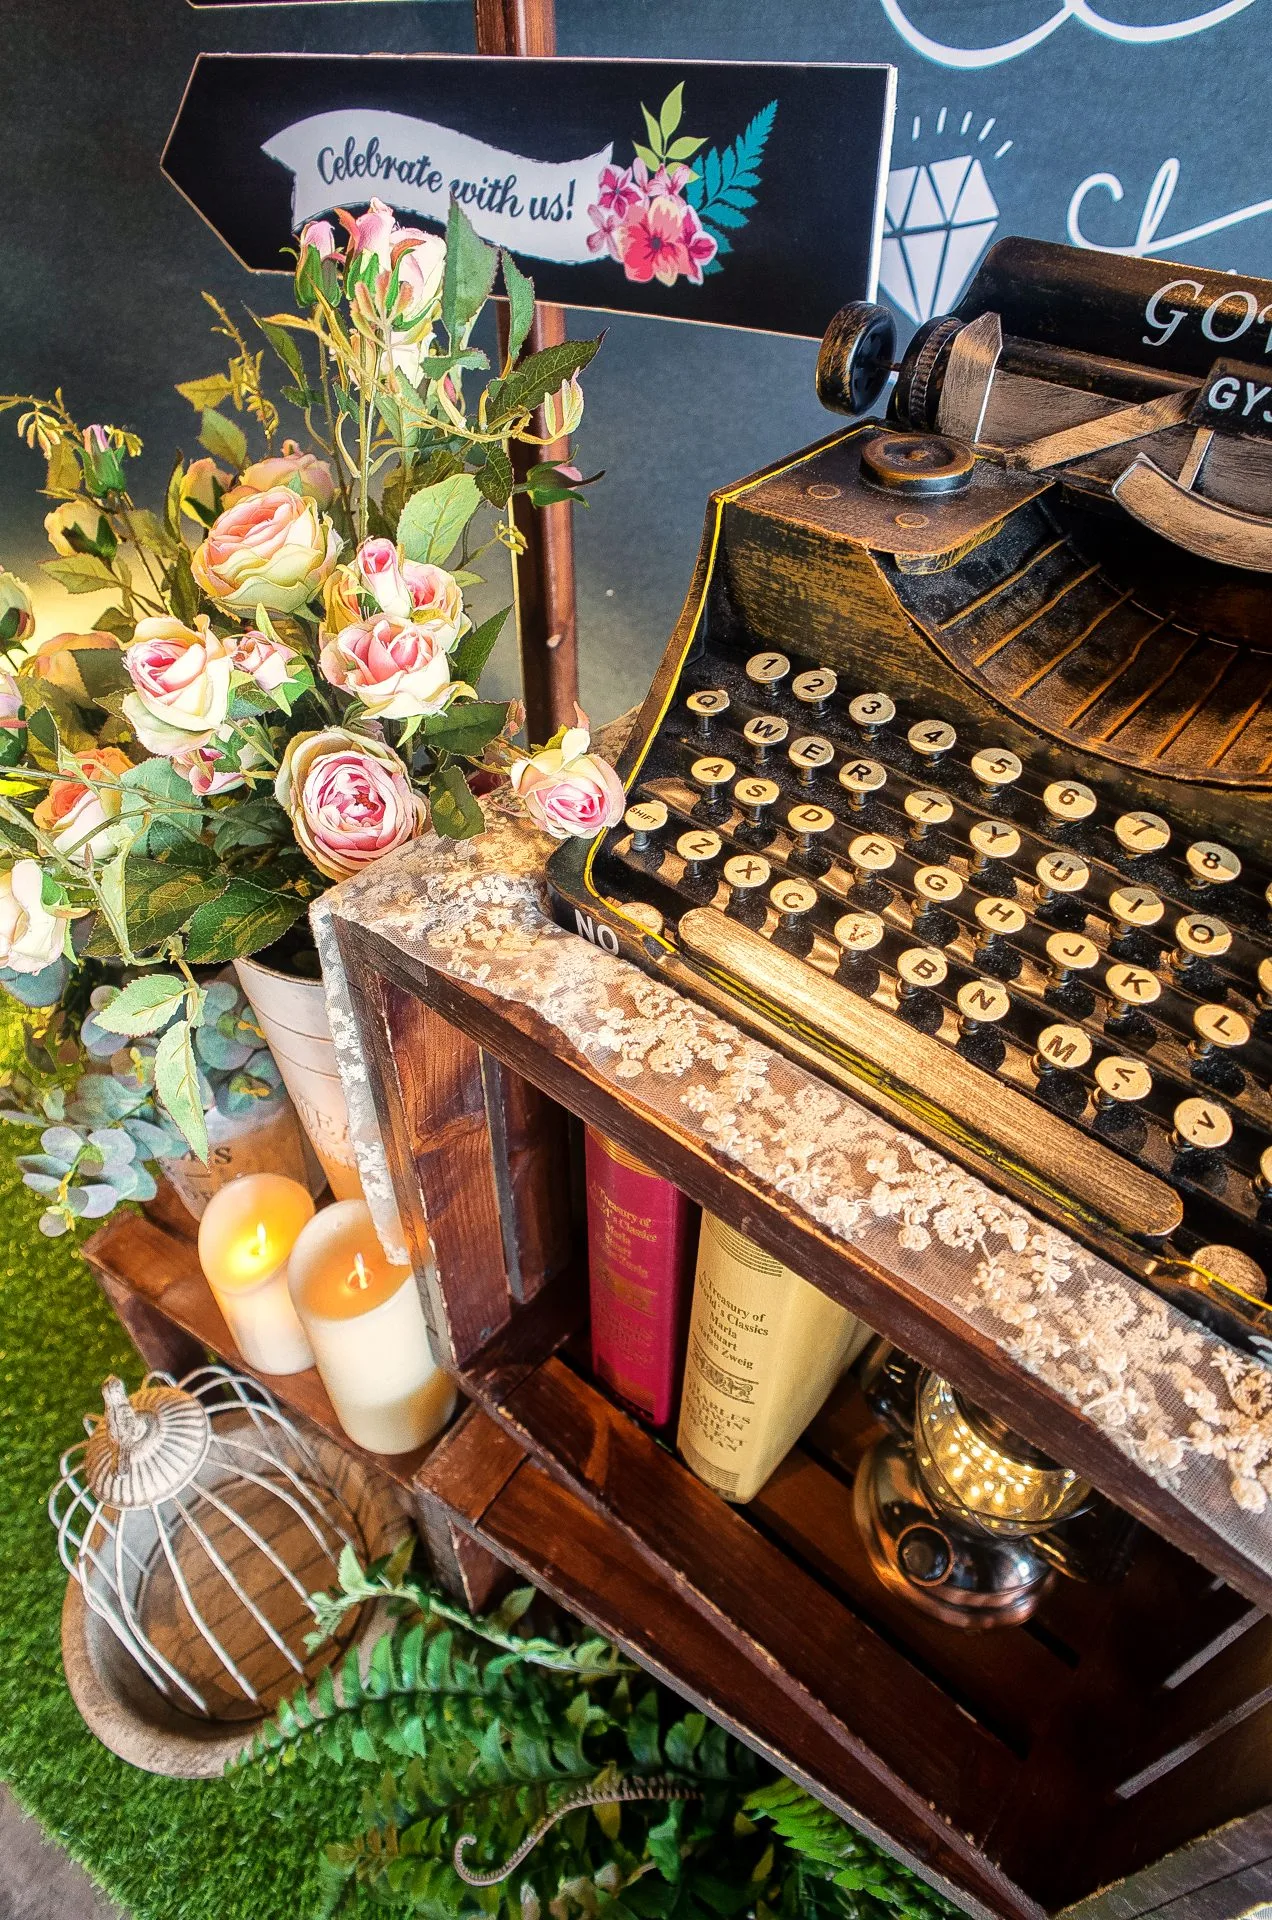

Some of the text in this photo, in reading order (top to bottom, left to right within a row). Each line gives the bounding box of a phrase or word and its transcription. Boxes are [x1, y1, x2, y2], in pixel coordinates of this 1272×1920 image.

[317, 135, 576, 222] Celebrate with us!
[762, 658, 777, 670] 1
[803, 679, 825, 692] 2
[696, 695, 718, 707] Q
[861, 701, 881, 715] 3
[752, 721, 782, 738] W
[926, 729, 945, 743] 4
[803, 743, 824, 760] E
[702, 763, 724, 777] A
[847, 763, 872, 781] R
[989, 758, 1012, 775] 5
[746, 784, 767, 798] S
[1058, 789, 1080, 805] 6
[921, 798, 942, 814] T
[630, 807, 657, 823] SHIFT
[800, 809, 822, 822] D
[988, 826, 1009, 843] Y
[1130, 818, 1157, 836] 7
[689, 838, 714, 854] Z
[859, 842, 884, 859] F
[1202, 852, 1221, 869] 8
[735, 861, 760, 879] X
[1050, 862, 1075, 880] U
[925, 874, 948, 891] G
[782, 892, 804, 908] C
[1130, 898, 1145, 913] I
[987, 903, 1015, 923] H
[1188, 923, 1214, 945] O
[1062, 944, 1085, 957] J
[912, 959, 938, 978] B
[1120, 972, 1151, 995] K
[969, 988, 996, 1011] N
[1213, 1015, 1231, 1037] L
[1045, 1036, 1077, 1062] M
[727, 1313, 769, 1336] Classics
[752, 1313, 766, 1322] of
[708, 1323, 737, 1351] Stuart
[721, 1348, 753, 1370] Zweig
